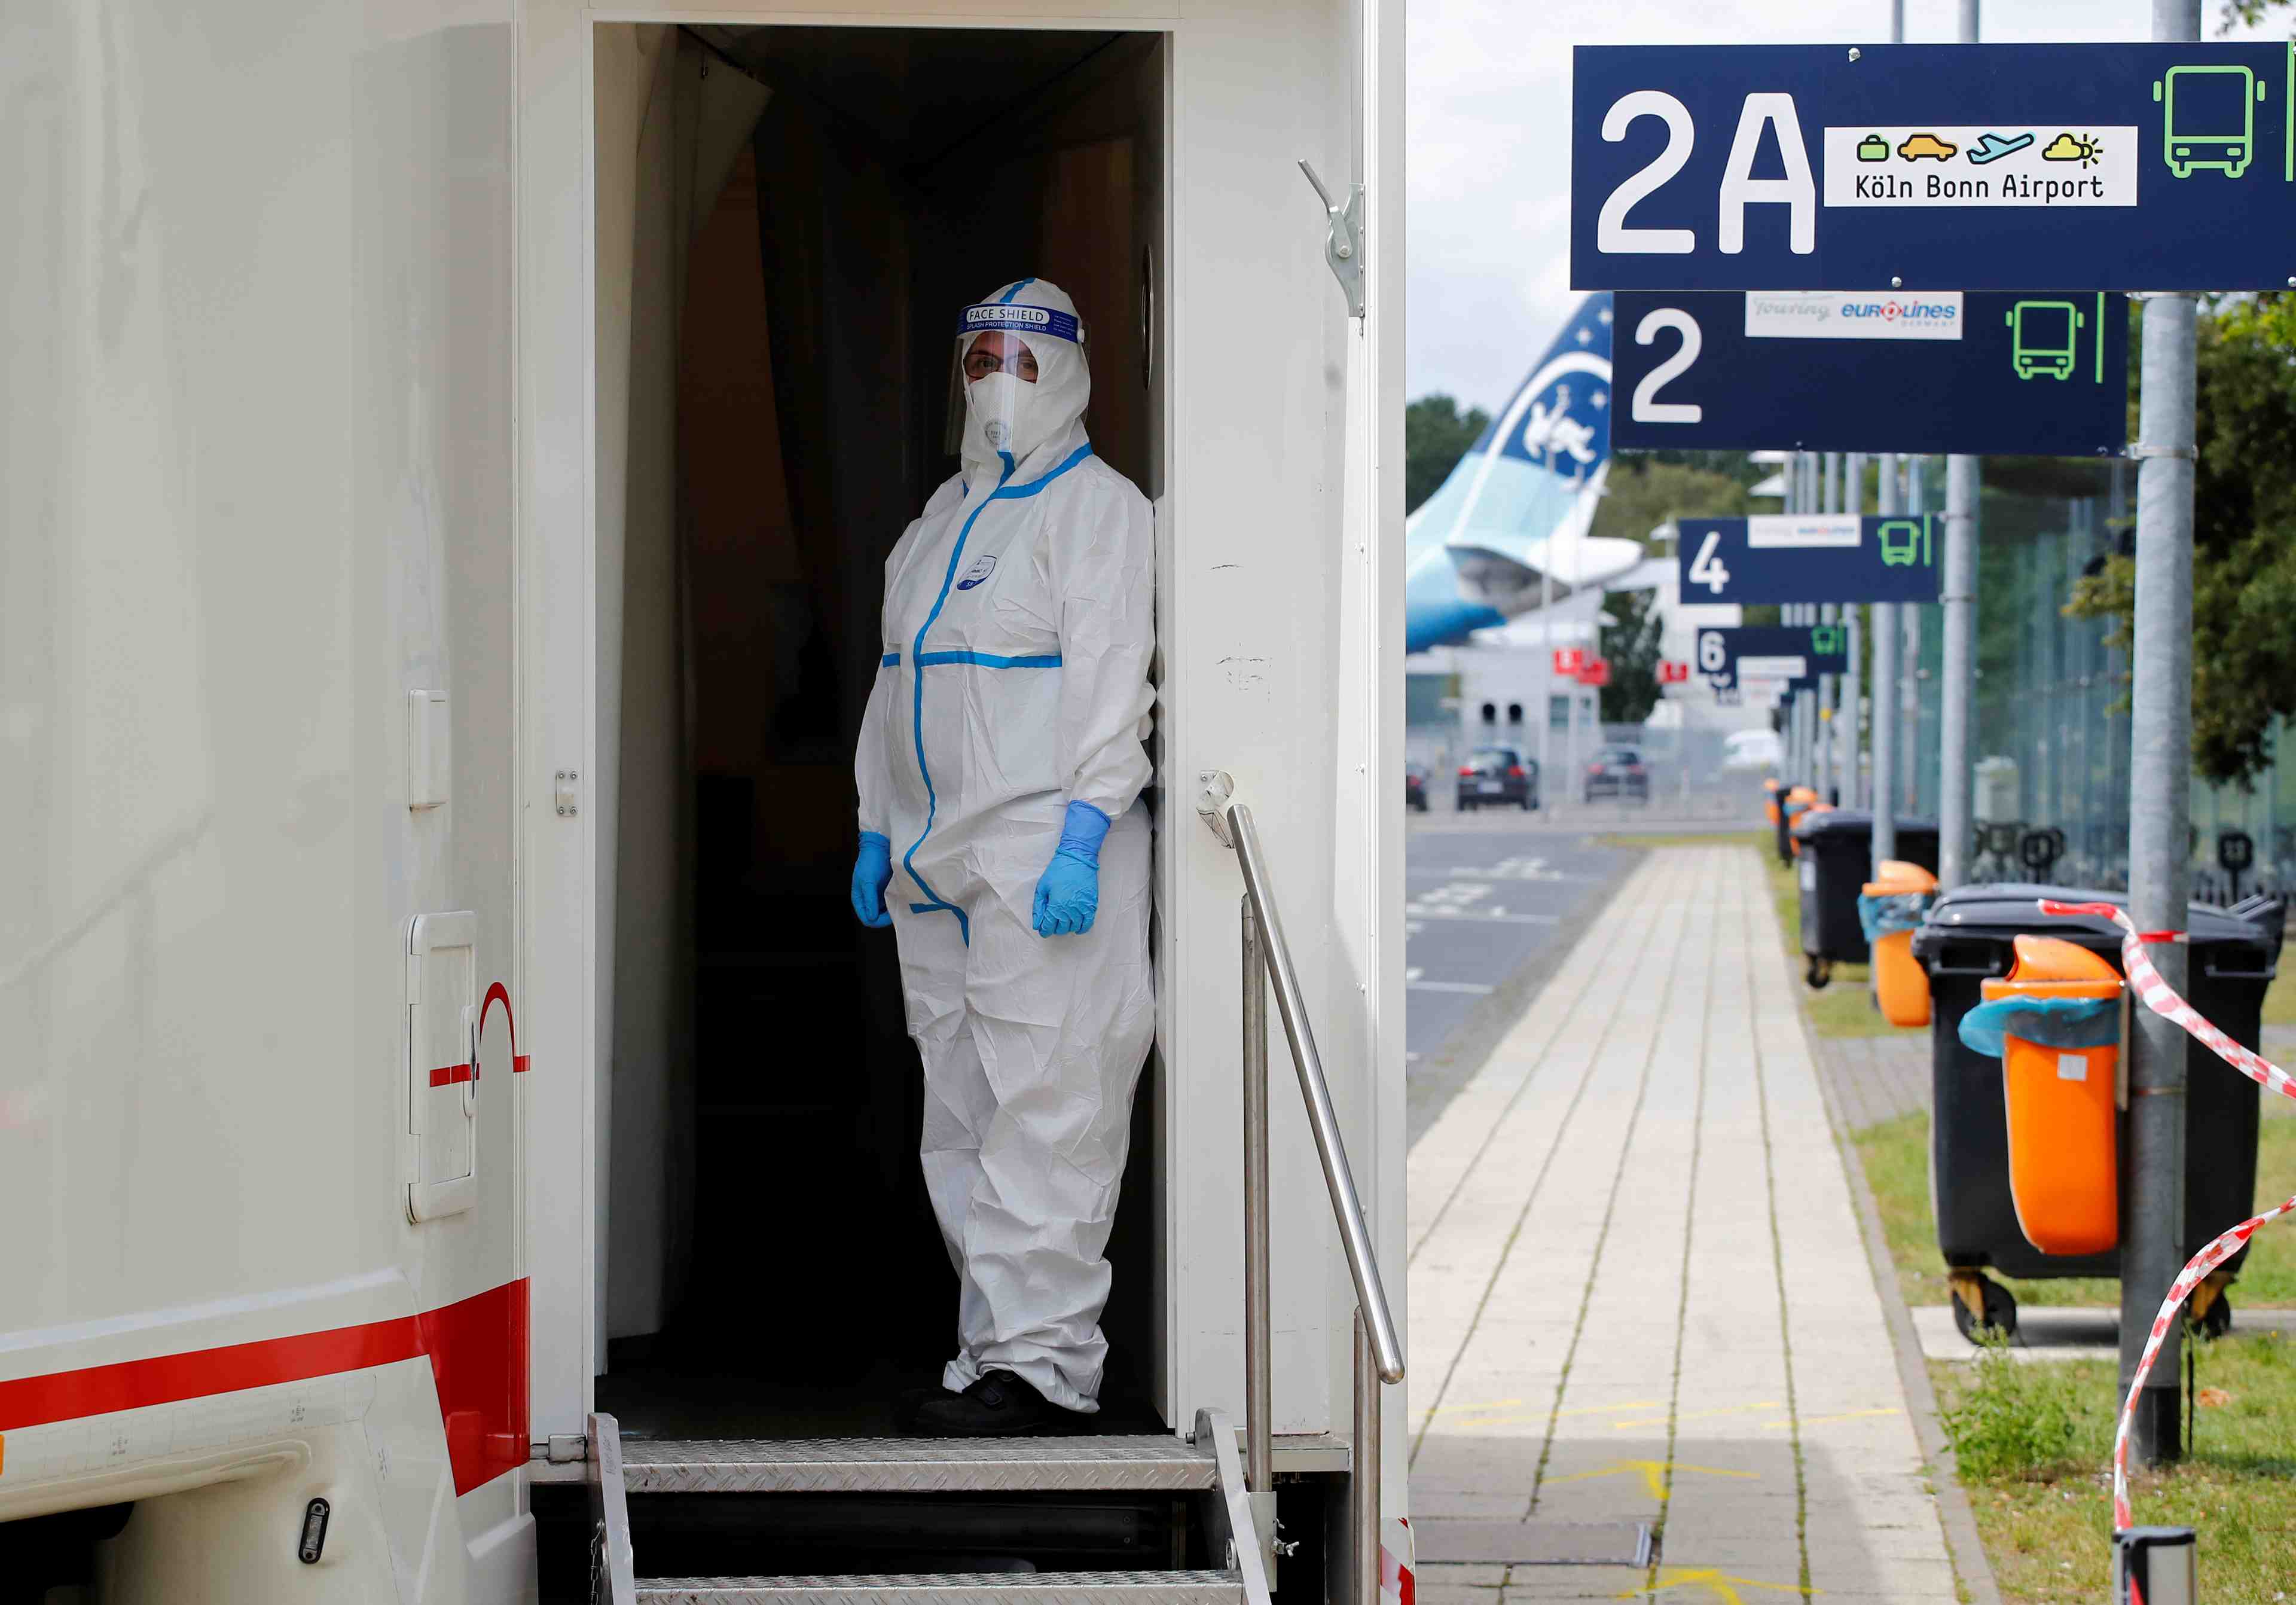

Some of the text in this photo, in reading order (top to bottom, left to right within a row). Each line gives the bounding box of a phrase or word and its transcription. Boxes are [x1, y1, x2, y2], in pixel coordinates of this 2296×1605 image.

[1597, 90, 1816, 254] 2A
[1857, 174, 2104, 204] Köln Bonn Airport
[969, 309, 1044, 322] FACE SHIELD
[985, 321, 1024, 329] PROTECTION
[1024, 322, 1047, 331] SHIELD
[1632, 308, 1702, 423] 2
[1689, 531, 1730, 594] 4
[1699, 631, 1726, 672] 6
